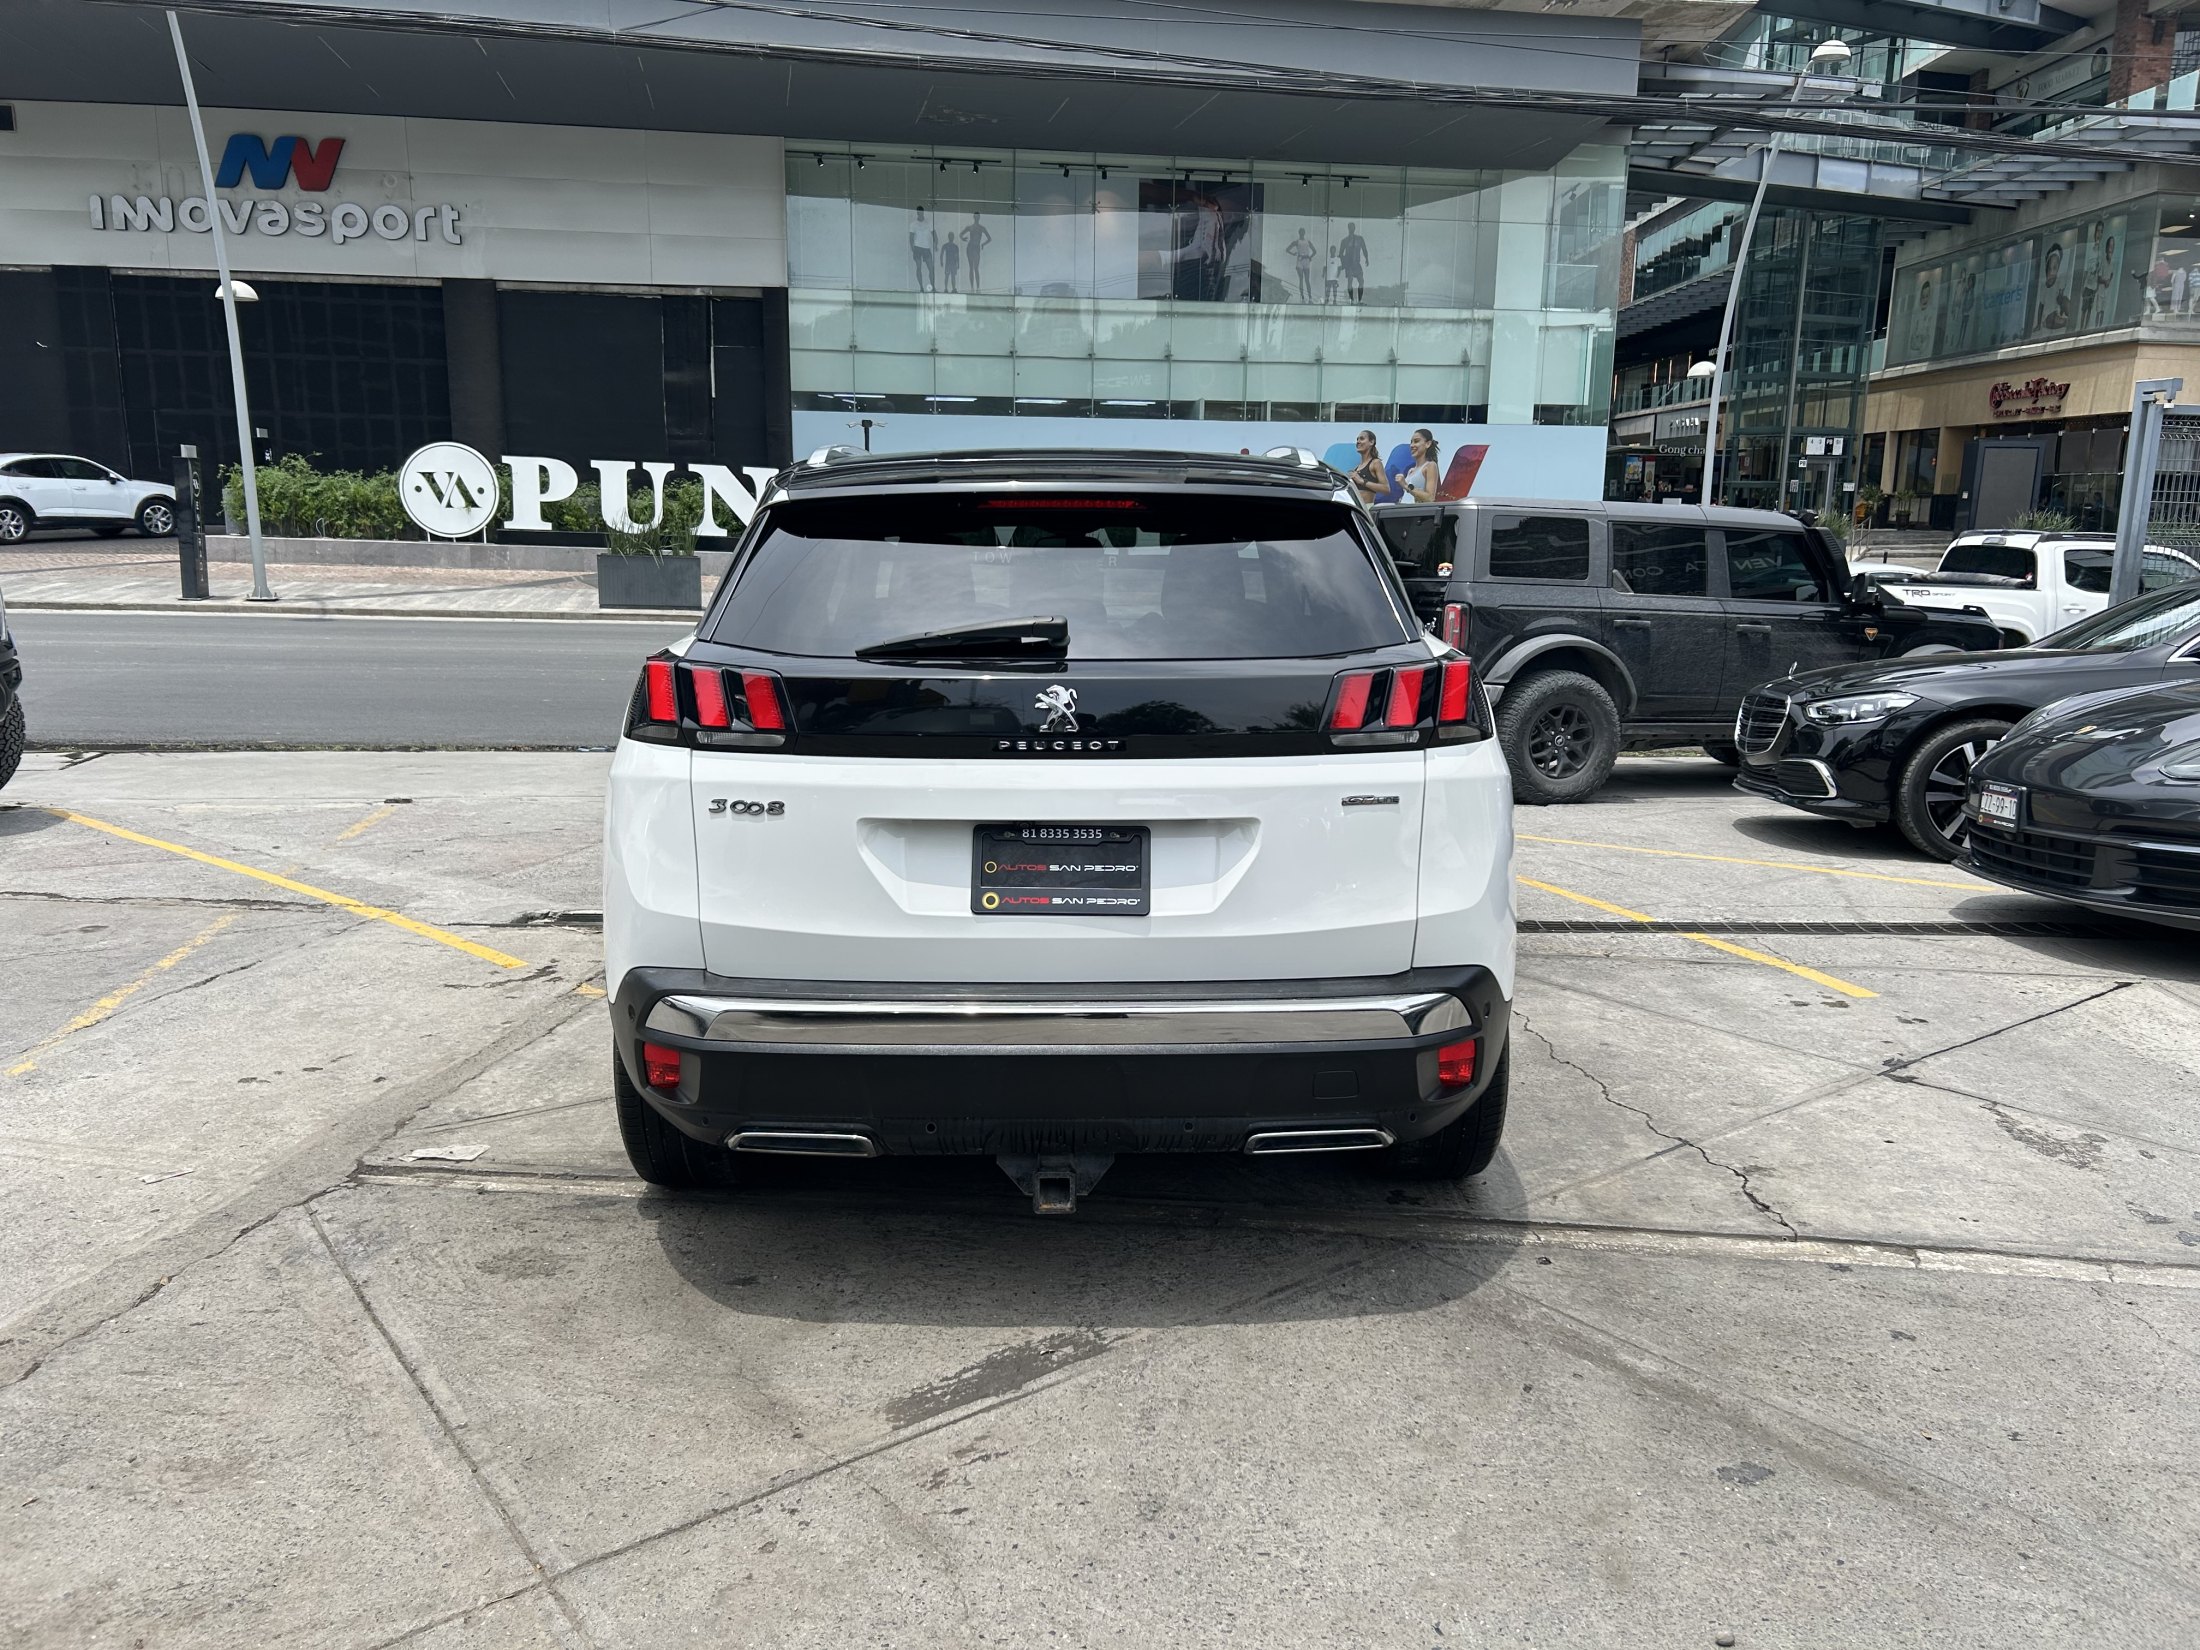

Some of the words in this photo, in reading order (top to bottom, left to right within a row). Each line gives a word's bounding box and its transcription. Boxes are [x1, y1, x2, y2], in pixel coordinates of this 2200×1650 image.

[1659, 444, 1687, 457] Gong
[1688, 445, 1707, 455] cha
[1902, 588, 1931, 598] TRD
[998, 740, 1120, 751] PEUGEOT
[708, 798, 786, 817] 3008
[1021, 829, 1037, 838] 81
[1040, 828, 1070, 839] 8335
[1073, 829, 1102, 839] 3535
[998, 863, 1047, 871] AUTOS
[1049, 864, 1081, 872] SAN
[1001, 896, 1050, 904] AUTOS
[1052, 897, 1084, 905] SAN
